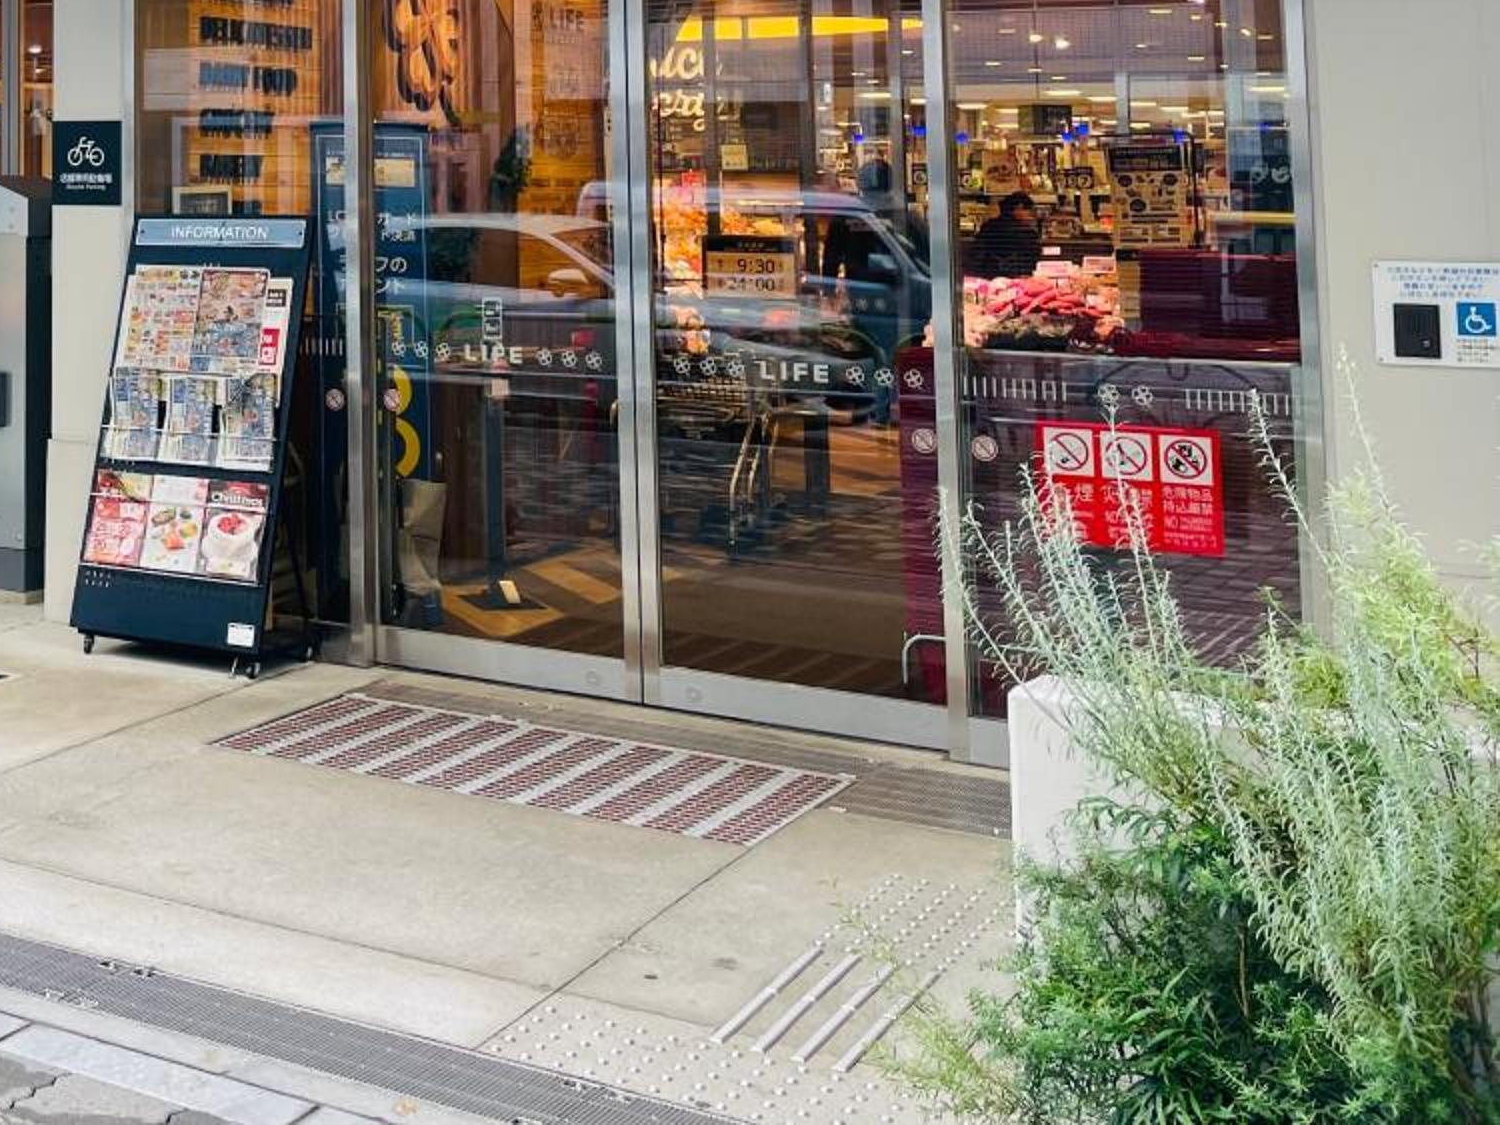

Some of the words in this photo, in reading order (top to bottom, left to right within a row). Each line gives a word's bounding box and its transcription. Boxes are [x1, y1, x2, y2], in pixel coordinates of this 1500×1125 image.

[171, 225, 269, 240] INFORMATION
[737, 258, 775, 274] 9:30
[463, 343, 524, 365] LIFE
[757, 360, 830, 384] LIFE
